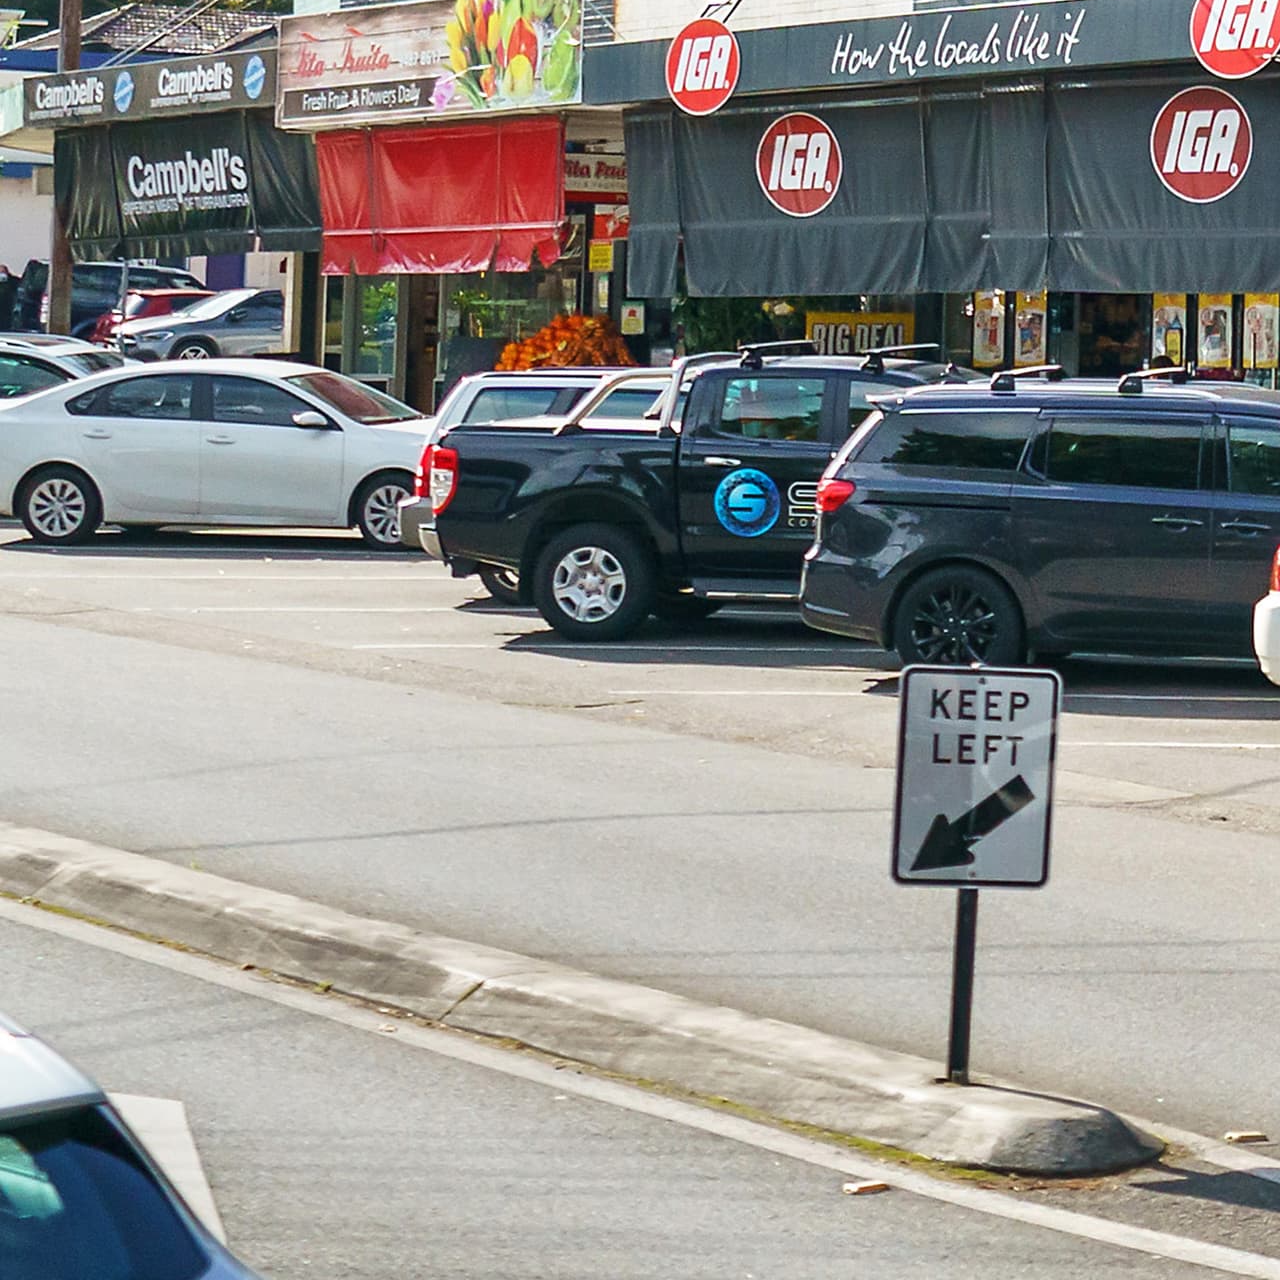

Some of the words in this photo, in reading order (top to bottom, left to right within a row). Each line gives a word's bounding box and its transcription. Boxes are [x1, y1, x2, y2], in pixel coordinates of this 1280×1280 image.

[831, 32, 884, 74] How
[889, 21, 928, 75] the
[934, 14, 1000, 68] locals
[1006, 9, 1050, 64] like
[1057, 8, 1085, 64] it
[158, 61, 233, 98] Campbell's
[673, 35, 732, 93] IGA
[36, 76, 104, 111] Campbell's
[303, 92, 327, 111] Fresh
[328, 90, 349, 109] Fruit
[352, 89, 359, 107] &
[361, 87, 396, 106] Flowers
[398, 83, 420, 106] Daily
[1163, 109, 1241, 174] IGA
[128, 148, 247, 203] Campbell's
[768, 132, 831, 191] IGA
[813, 324, 849, 355] BIG
[855, 324, 904, 356] DEAL
[930, 689, 1029, 721] KEEP
[932, 733, 1023, 766] LEFT
